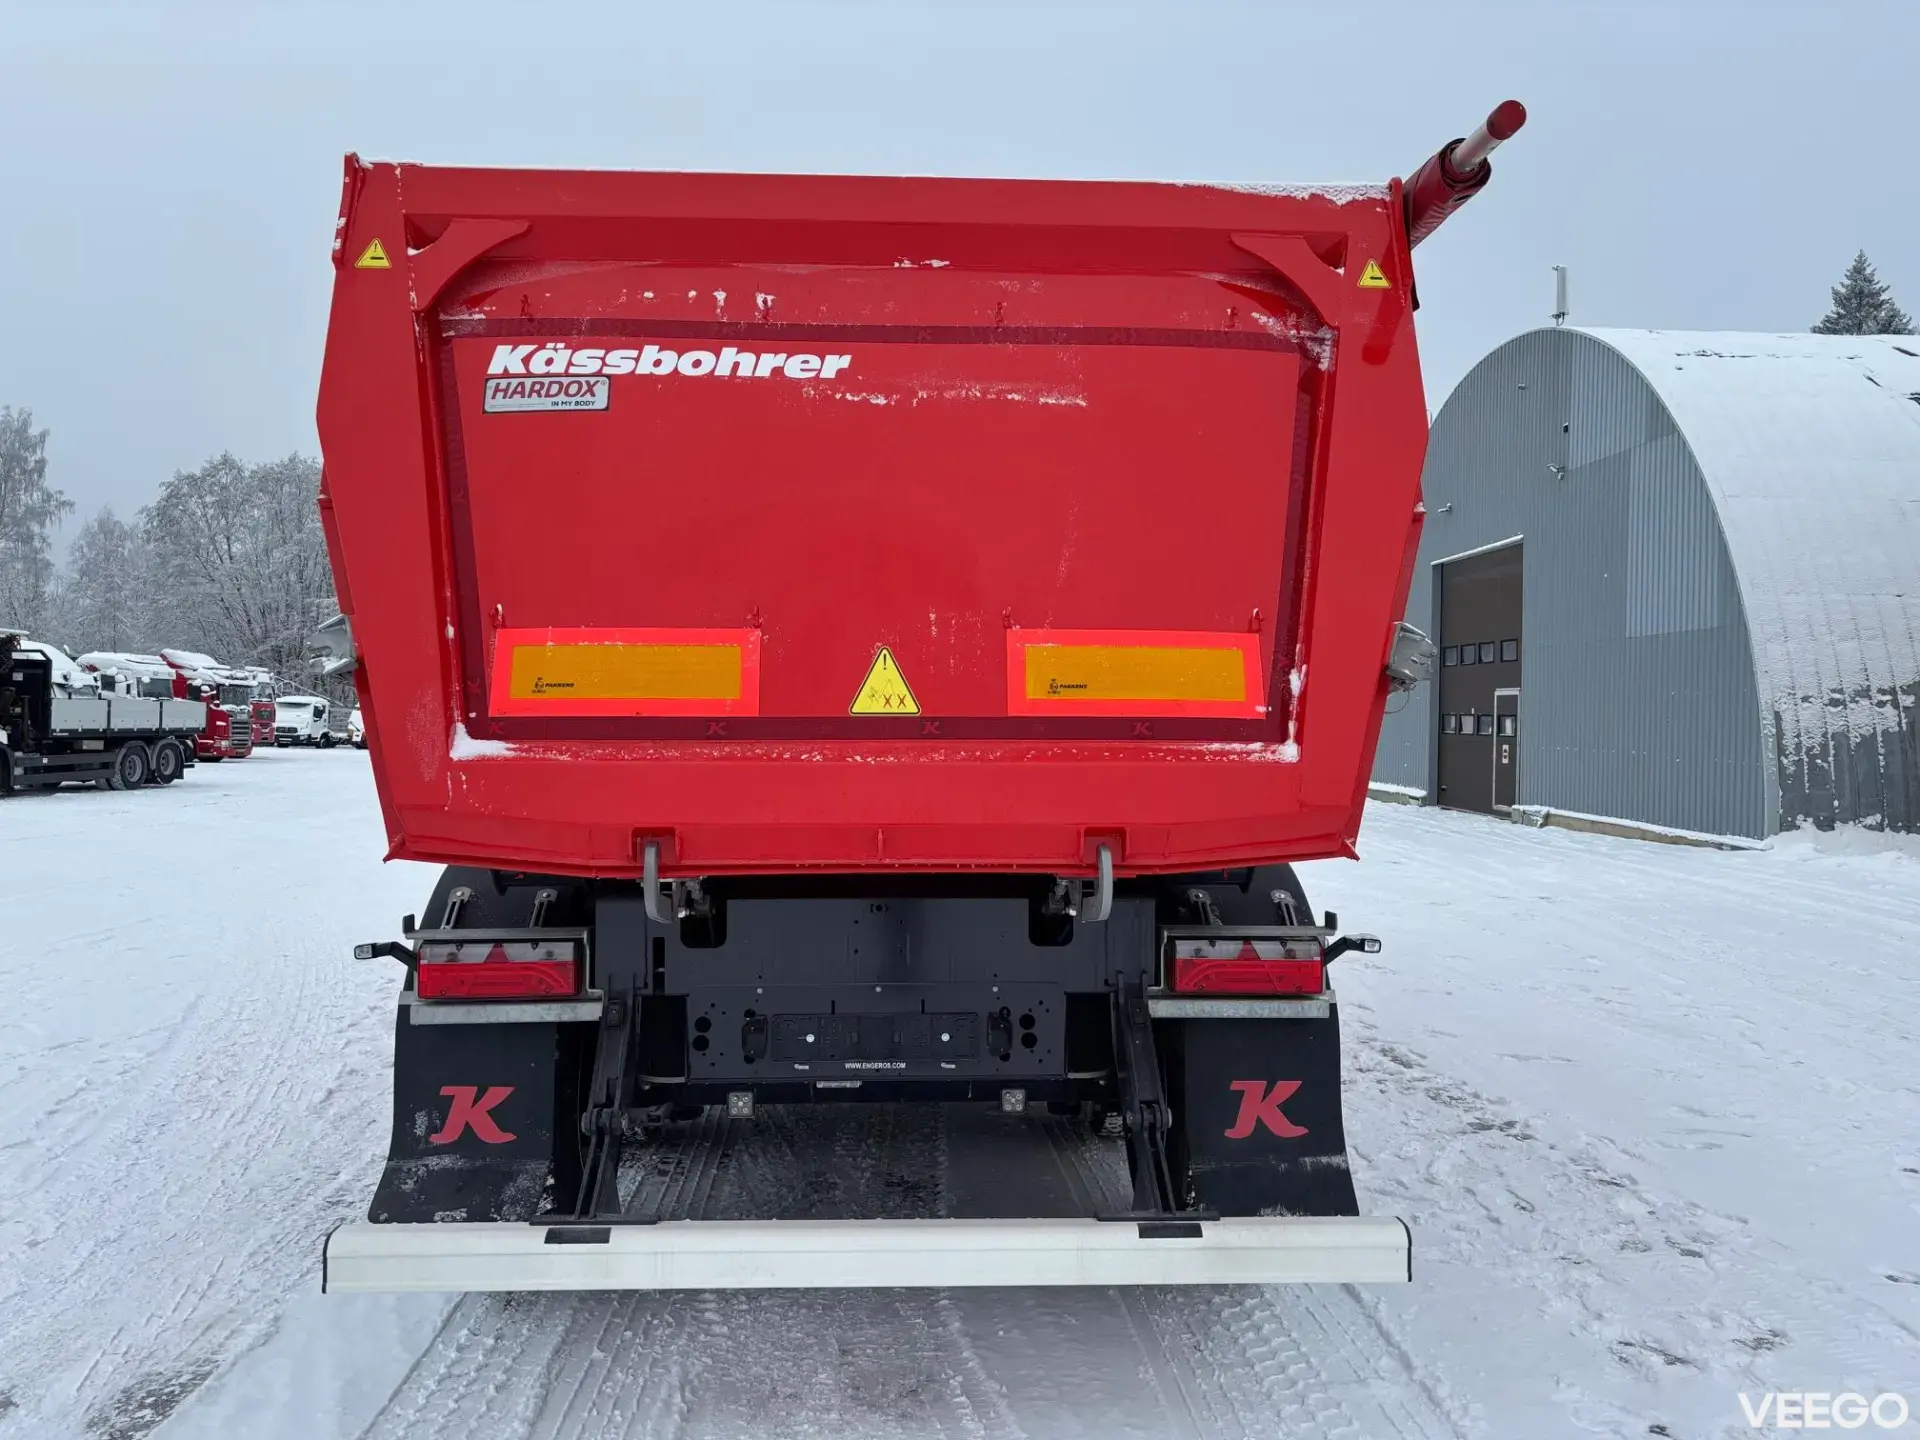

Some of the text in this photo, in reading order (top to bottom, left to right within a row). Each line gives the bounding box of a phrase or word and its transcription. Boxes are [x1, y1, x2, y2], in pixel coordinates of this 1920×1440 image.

[487, 342, 852, 379] Kässbohrer
[491, 380, 600, 400] HARDOX
[428, 1086, 518, 1144] K
[1224, 1080, 1309, 1139] K
